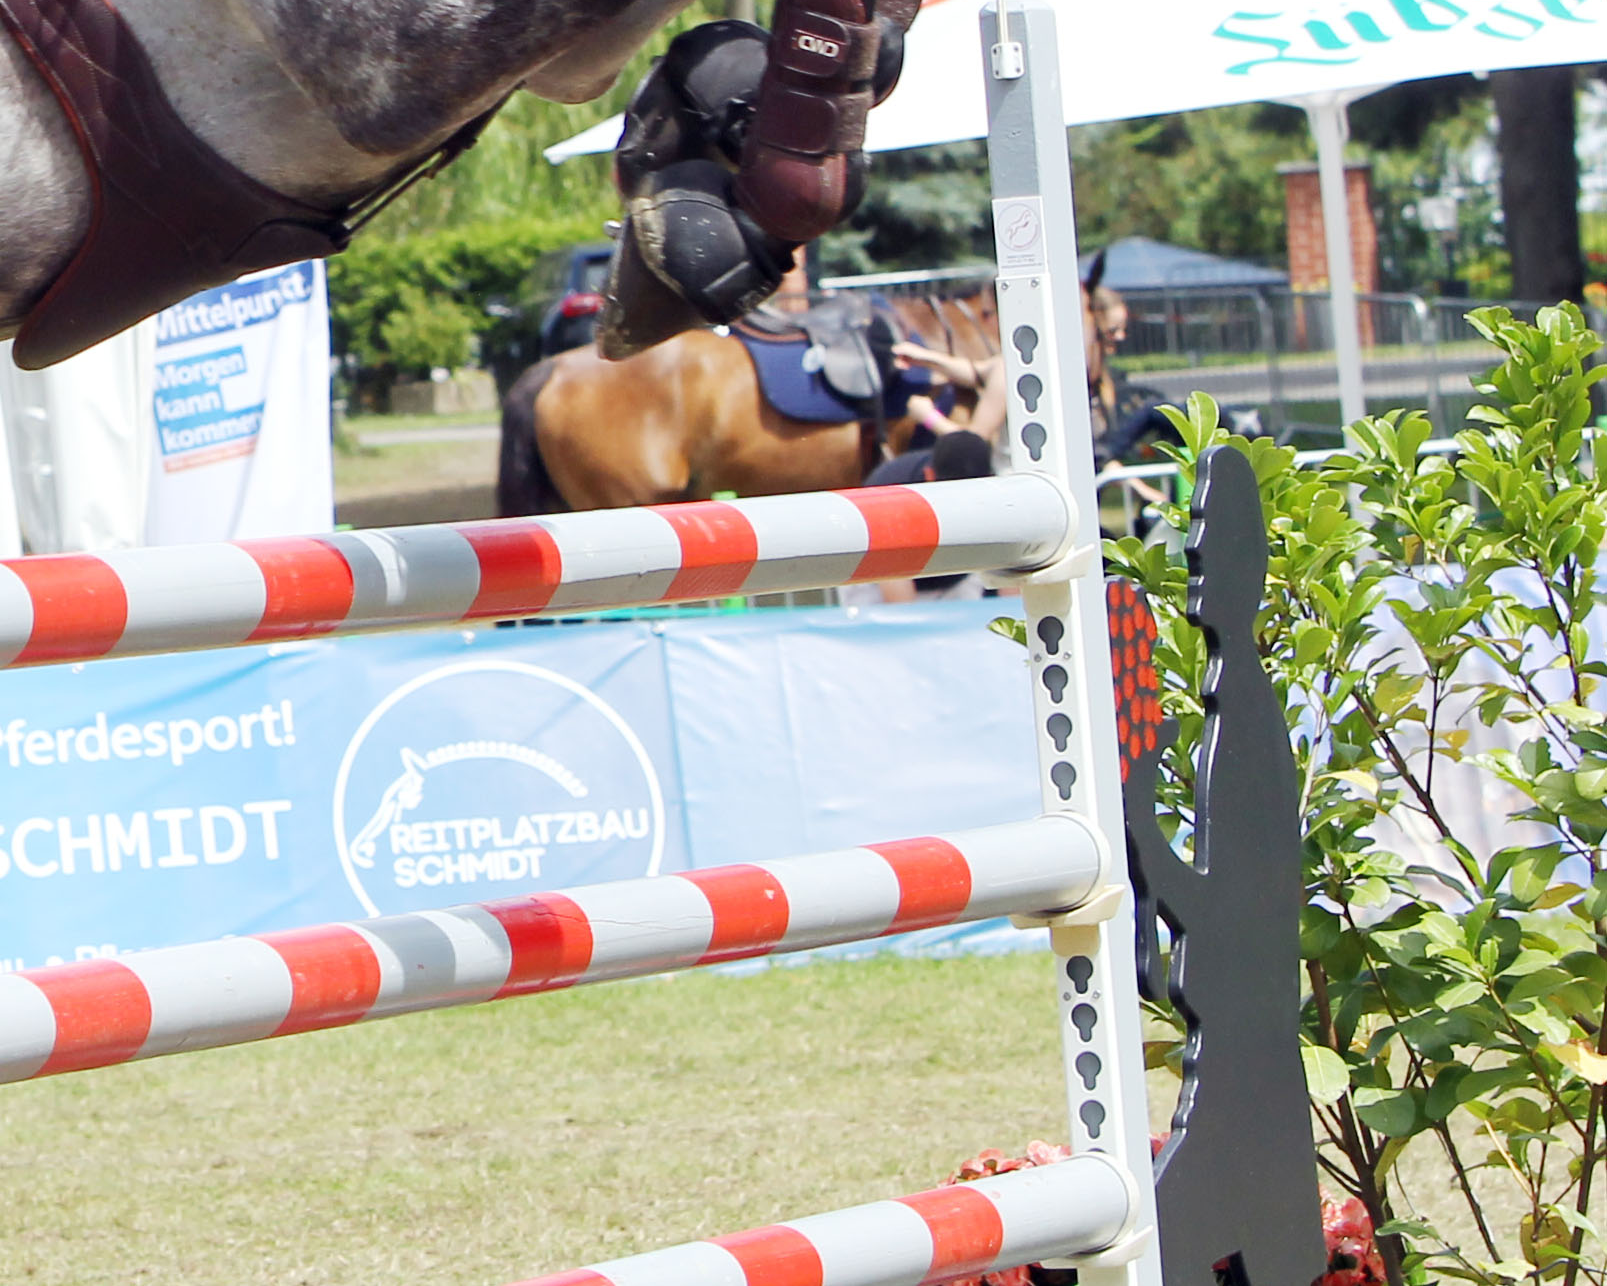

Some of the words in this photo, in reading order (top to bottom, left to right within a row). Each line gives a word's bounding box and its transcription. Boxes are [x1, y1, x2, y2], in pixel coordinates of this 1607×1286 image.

[156, 391, 221, 421] kann
[390, 807, 651, 855] REITPLATZBAU
[393, 846, 546, 889] SCHMIDT
